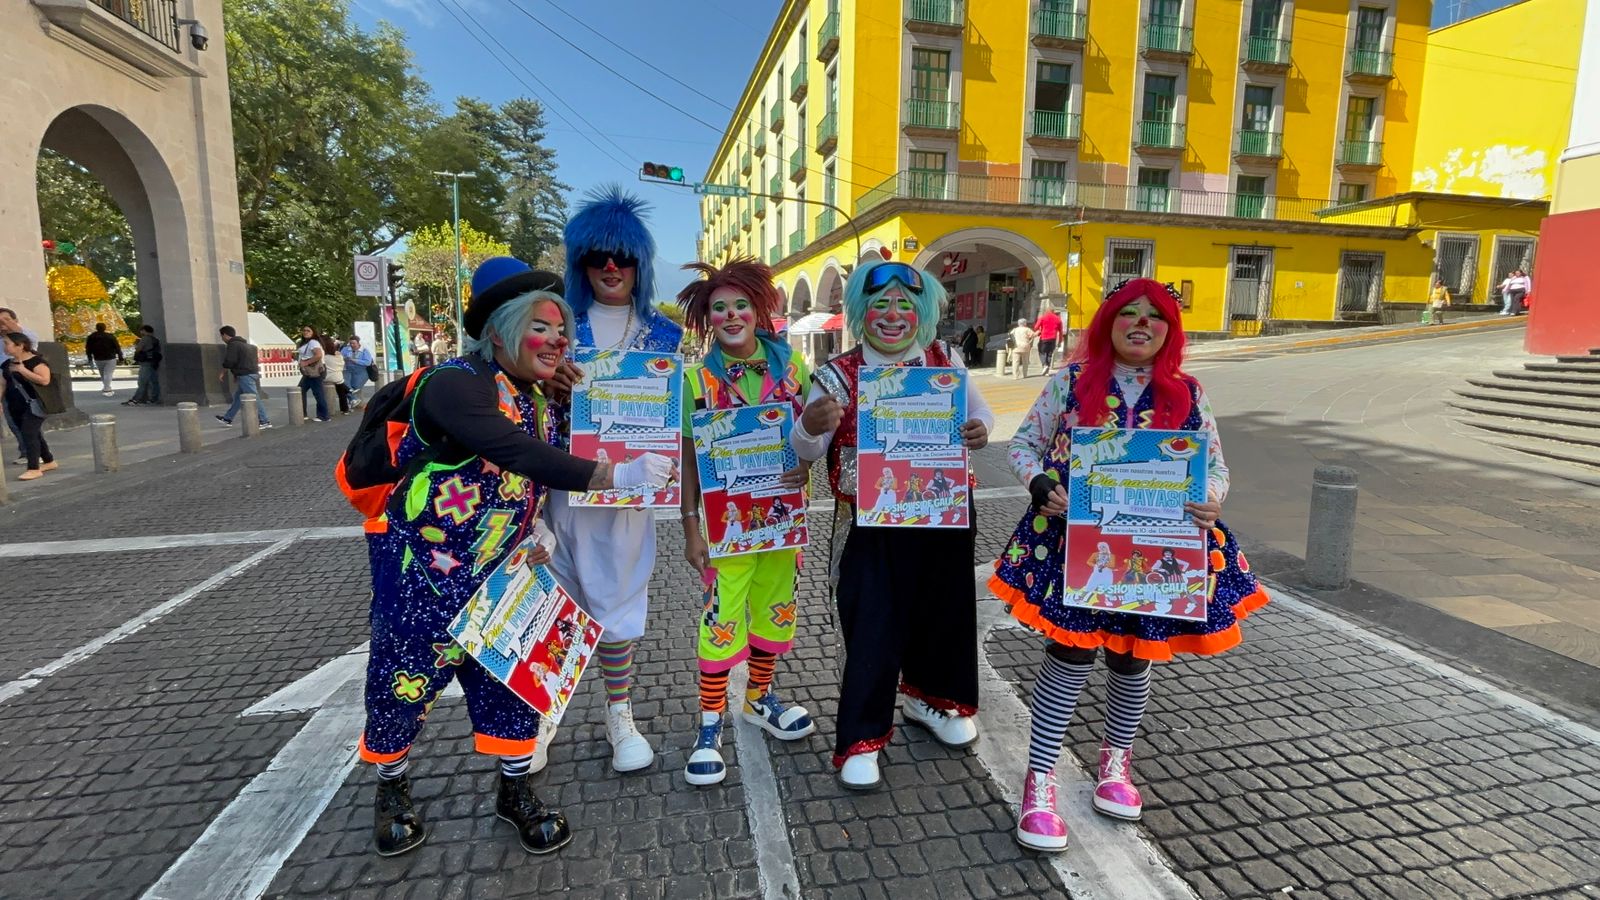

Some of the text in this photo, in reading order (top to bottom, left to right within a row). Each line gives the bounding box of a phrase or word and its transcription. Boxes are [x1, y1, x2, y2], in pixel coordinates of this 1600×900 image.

[363, 265, 373, 274] 30
[591, 400, 669, 417] DEL PAYASO
[877, 419, 954, 434] DEL PAYASO
[715, 457, 736, 472] DEL
[740, 450, 786, 468] PAYASO
[1092, 486, 1189, 508] DEL PAYASO
